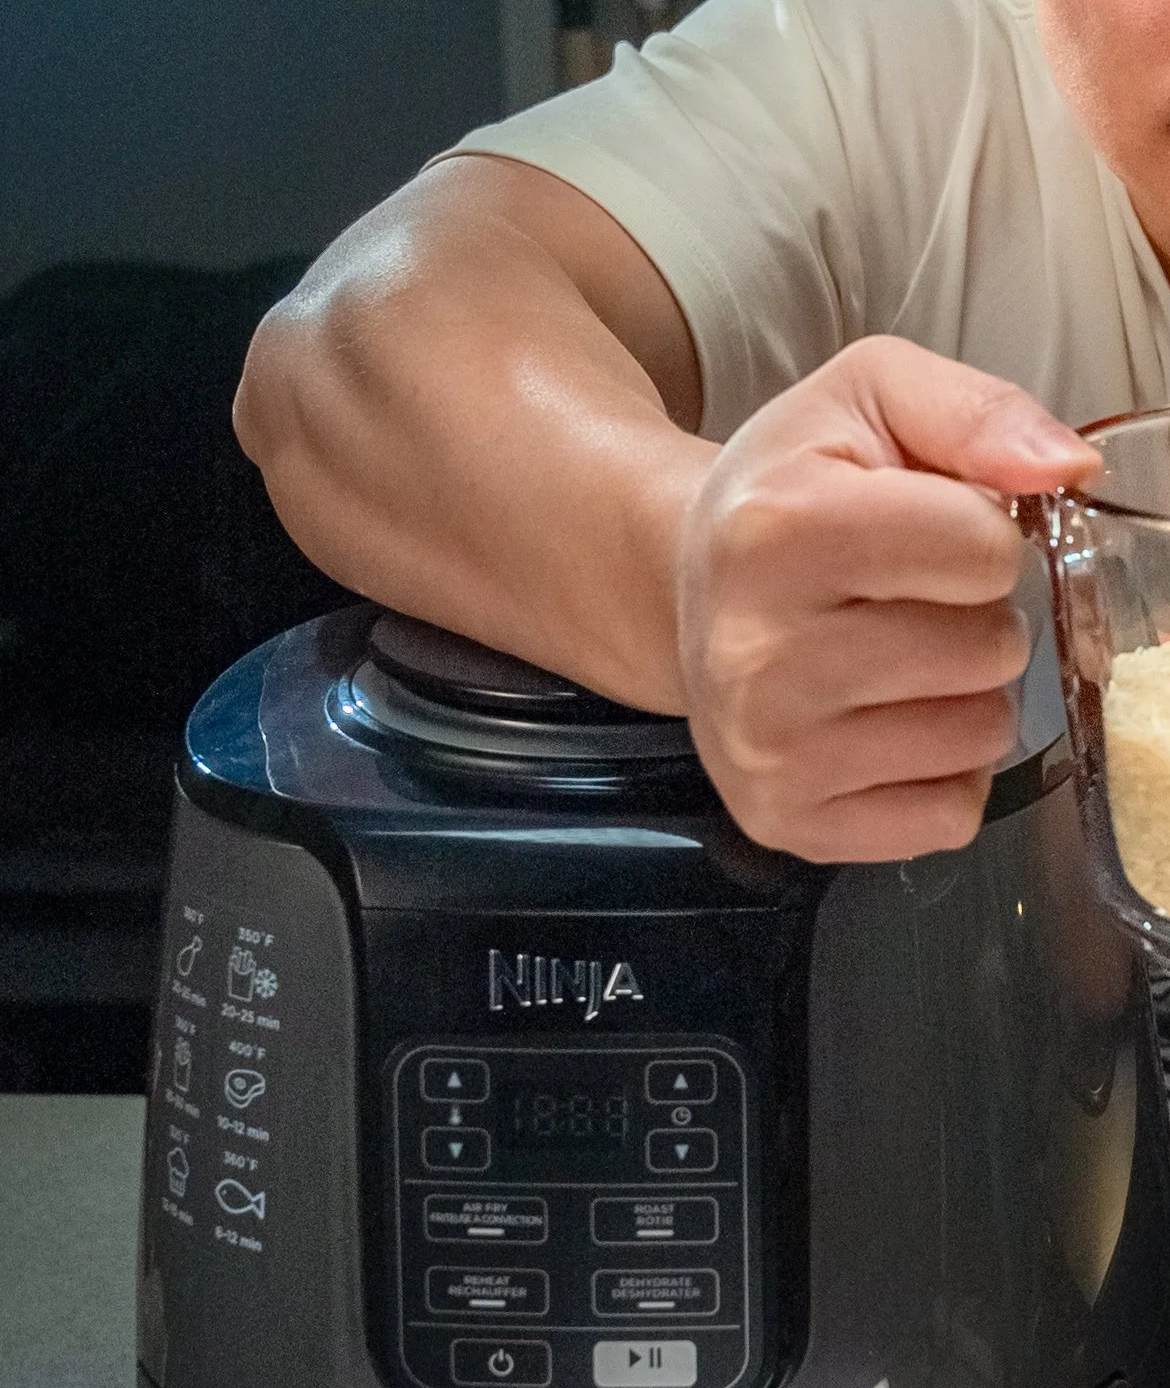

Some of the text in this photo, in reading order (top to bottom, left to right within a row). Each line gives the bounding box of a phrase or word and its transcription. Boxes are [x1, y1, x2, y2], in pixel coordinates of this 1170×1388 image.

[489, 949, 644, 1021] NINJA
[634, 1203, 675, 1214] ROAST
[619, 1277, 692, 1288] DEHYDRATE
